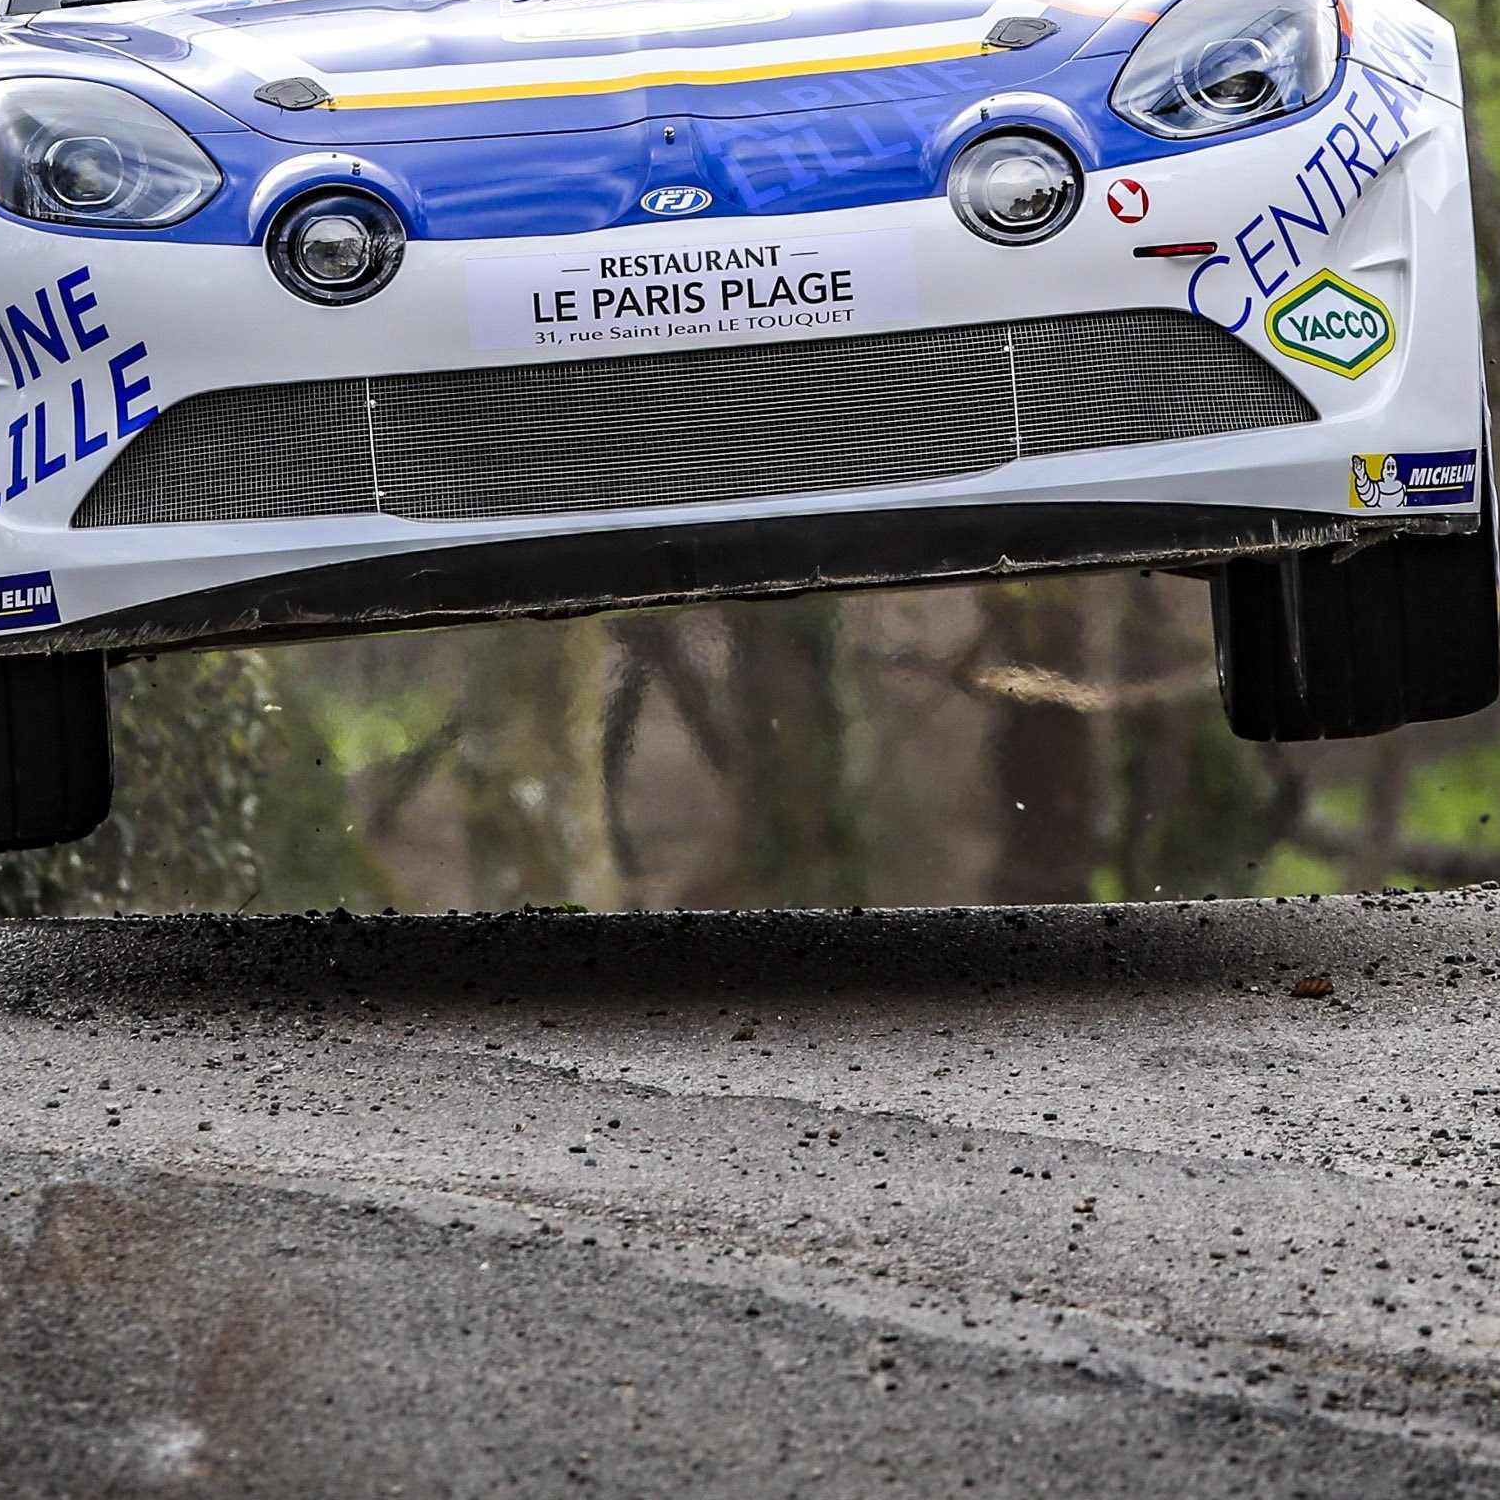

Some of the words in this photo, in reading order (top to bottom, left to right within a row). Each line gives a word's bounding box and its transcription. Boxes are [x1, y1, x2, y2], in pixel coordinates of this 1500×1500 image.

[654, 194, 696, 211] FJ
[600, 245, 781, 279] RESTAURANT
[533, 290, 579, 324] LE
[592, 281, 706, 320] PARIS
[721, 269, 854, 311] PLAGE
[535, 331, 563, 347] 31,
[569, 331, 603, 343] rue
[610, 325, 661, 340] Saint
[666, 322, 711, 338] Jean
[718, 318, 740, 332] LE
[747, 309, 856, 330] TOUQUET
[1288, 311, 1378, 342] YACCO
[1409, 463, 1477, 486] MICHELIN
